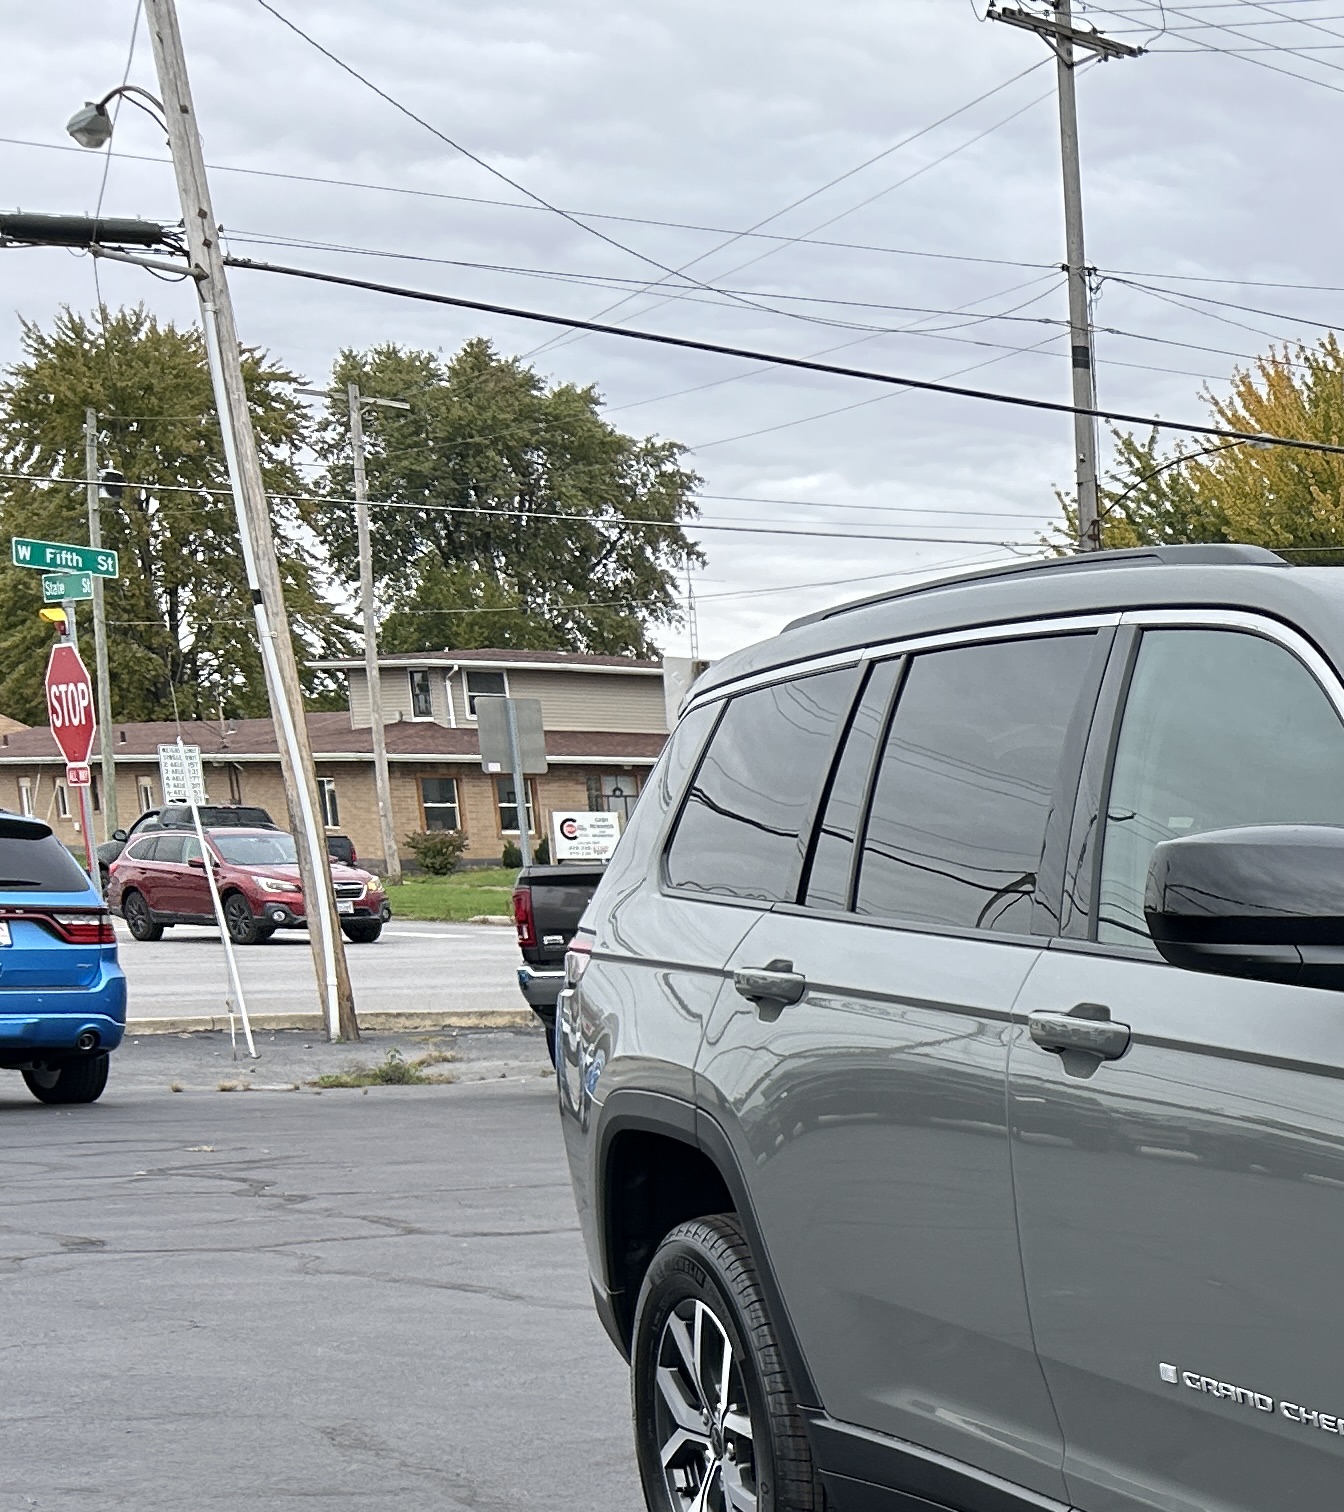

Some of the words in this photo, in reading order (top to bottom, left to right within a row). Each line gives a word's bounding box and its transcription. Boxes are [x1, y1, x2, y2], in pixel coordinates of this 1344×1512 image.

[17, 544, 31, 561] W
[45, 548, 83, 568] Fifth
[97, 555, 114, 572] St
[45, 580, 65, 596] State
[81, 577, 92, 593] St
[50, 682, 89, 728] STOP
[1182, 1370, 1274, 1412] GRAND
